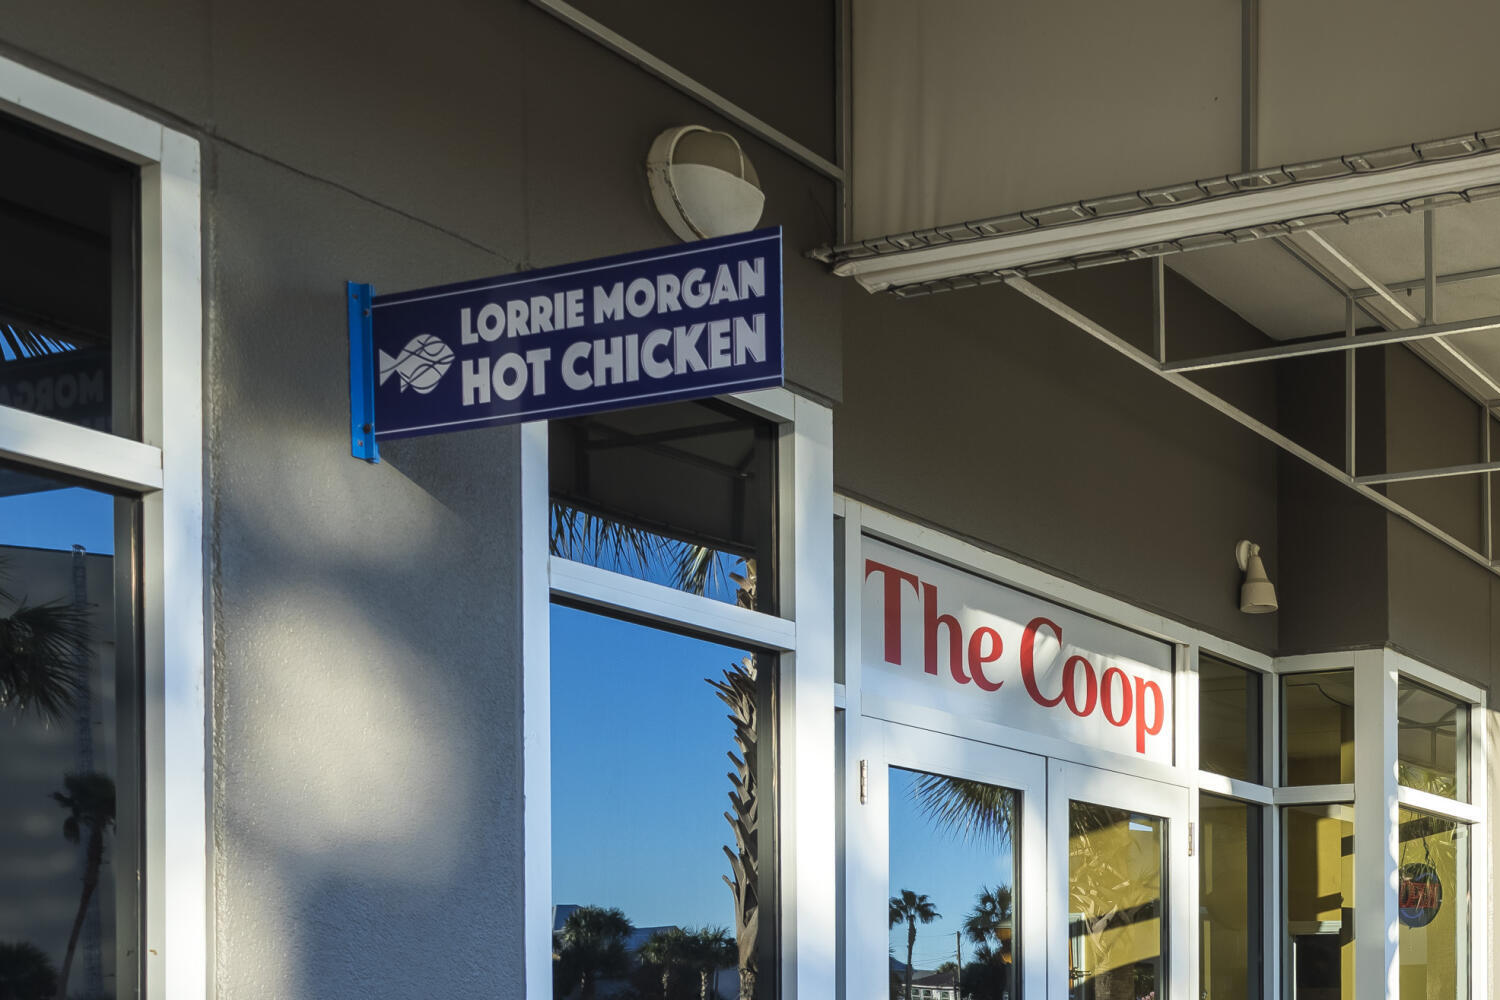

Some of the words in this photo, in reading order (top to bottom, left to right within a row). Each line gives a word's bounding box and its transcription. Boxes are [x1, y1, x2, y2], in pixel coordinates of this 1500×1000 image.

[461, 288, 585, 345] LORRIE
[594, 256, 766, 321] MORGAN
[462, 348, 552, 406] HOT
[561, 313, 767, 391] CHICKEN
[865, 558, 1004, 692] The
[1020, 617, 1165, 754] Coop
